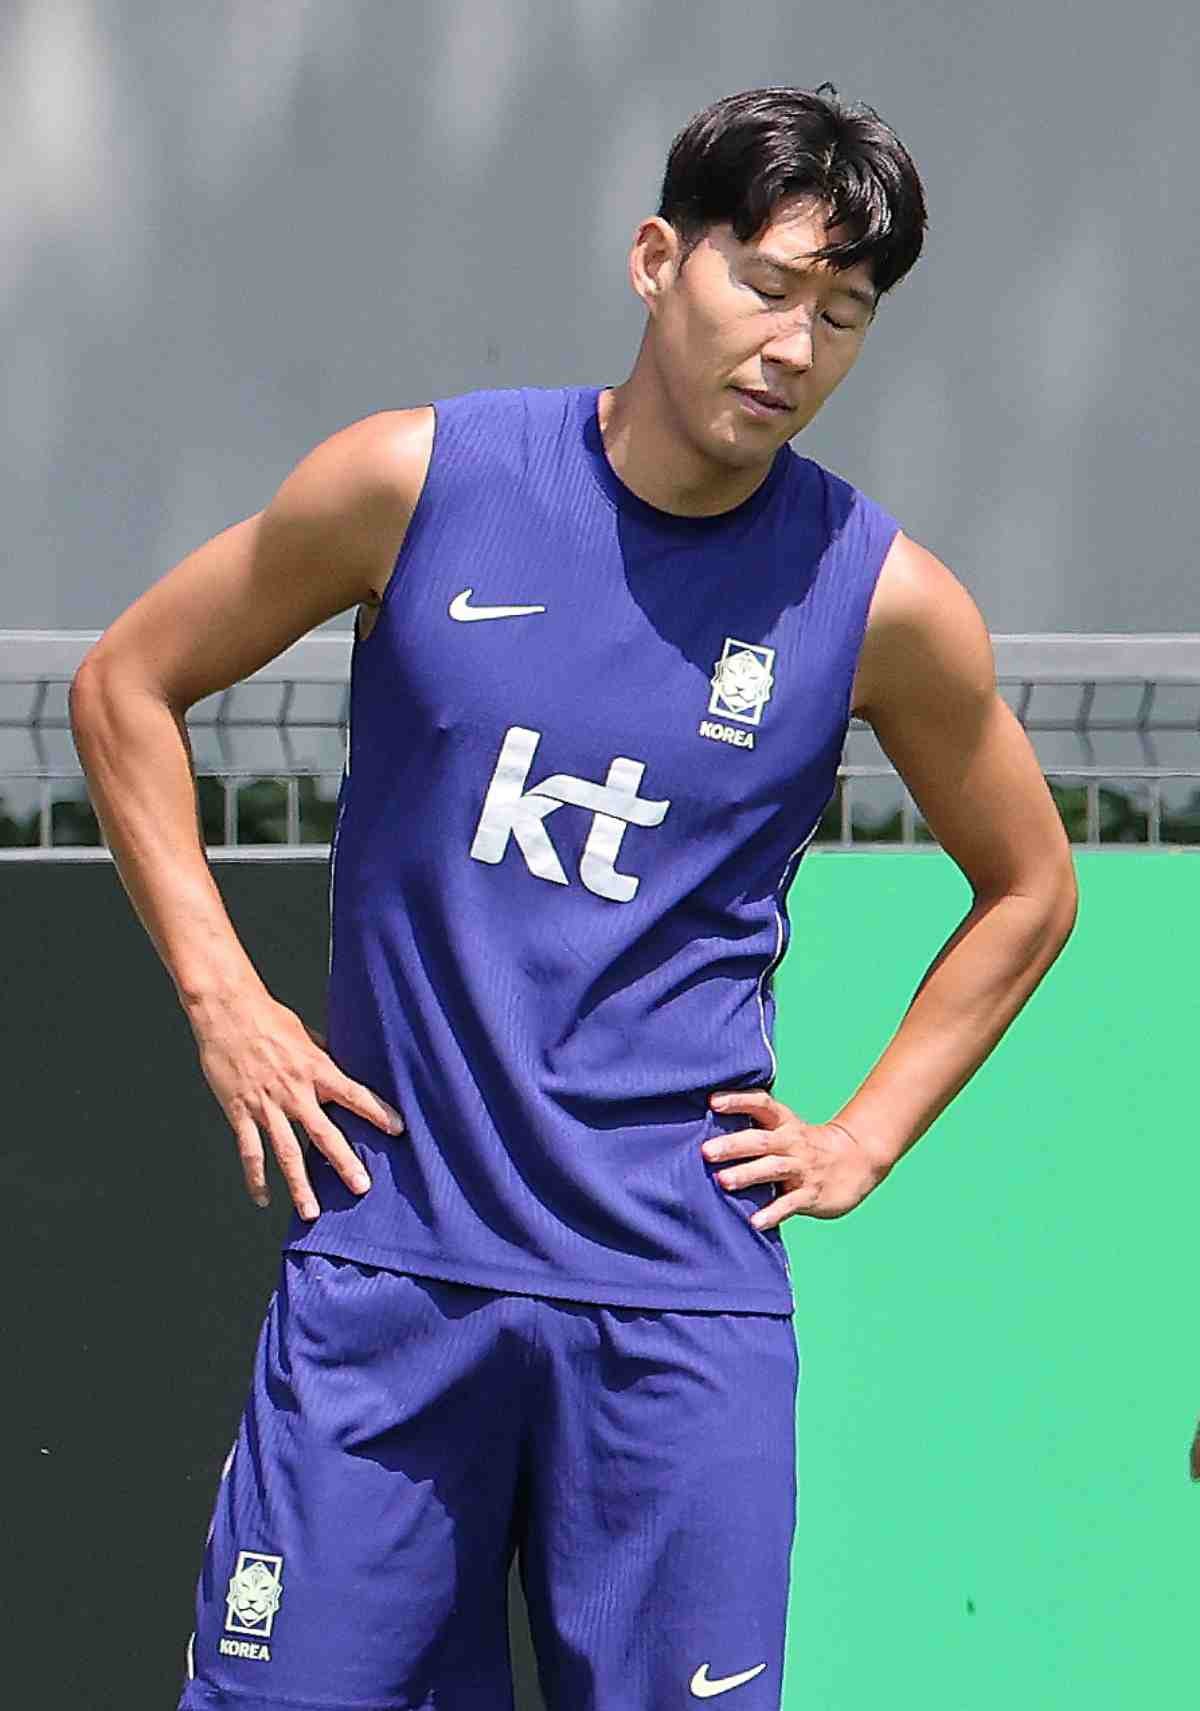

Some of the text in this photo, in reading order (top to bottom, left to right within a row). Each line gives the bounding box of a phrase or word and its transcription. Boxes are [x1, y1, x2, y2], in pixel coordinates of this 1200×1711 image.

[699, 720, 754, 749] KOREA
[470, 726, 671, 902] kt
[219, 1638, 270, 1661] KOREA
